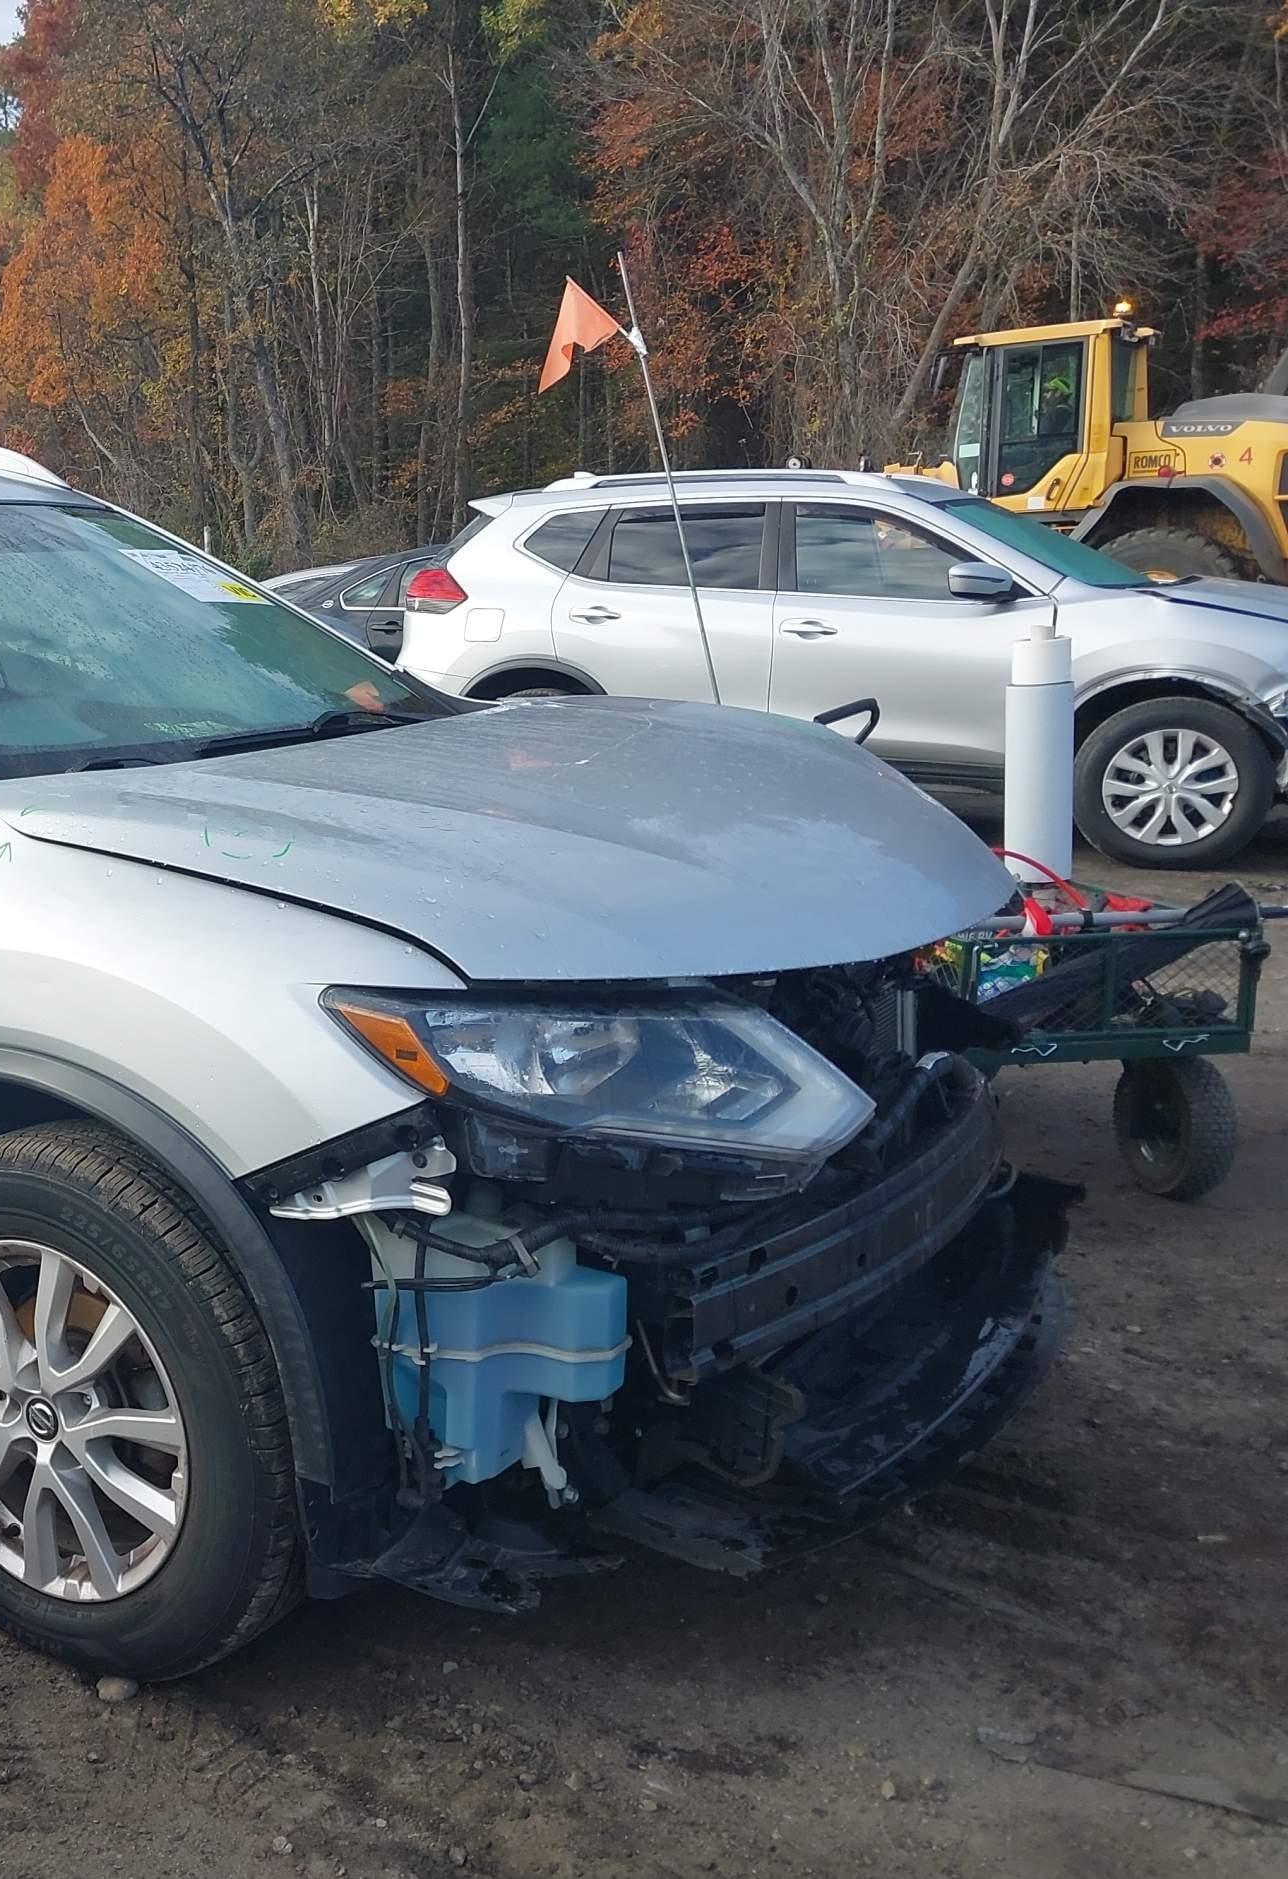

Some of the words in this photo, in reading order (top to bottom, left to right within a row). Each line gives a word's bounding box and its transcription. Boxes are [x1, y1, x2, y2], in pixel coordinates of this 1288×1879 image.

[1170, 424, 1232, 433] VOLVO
[1133, 454, 1171, 469] ROMCO
[1239, 447, 1253, 465] 4
